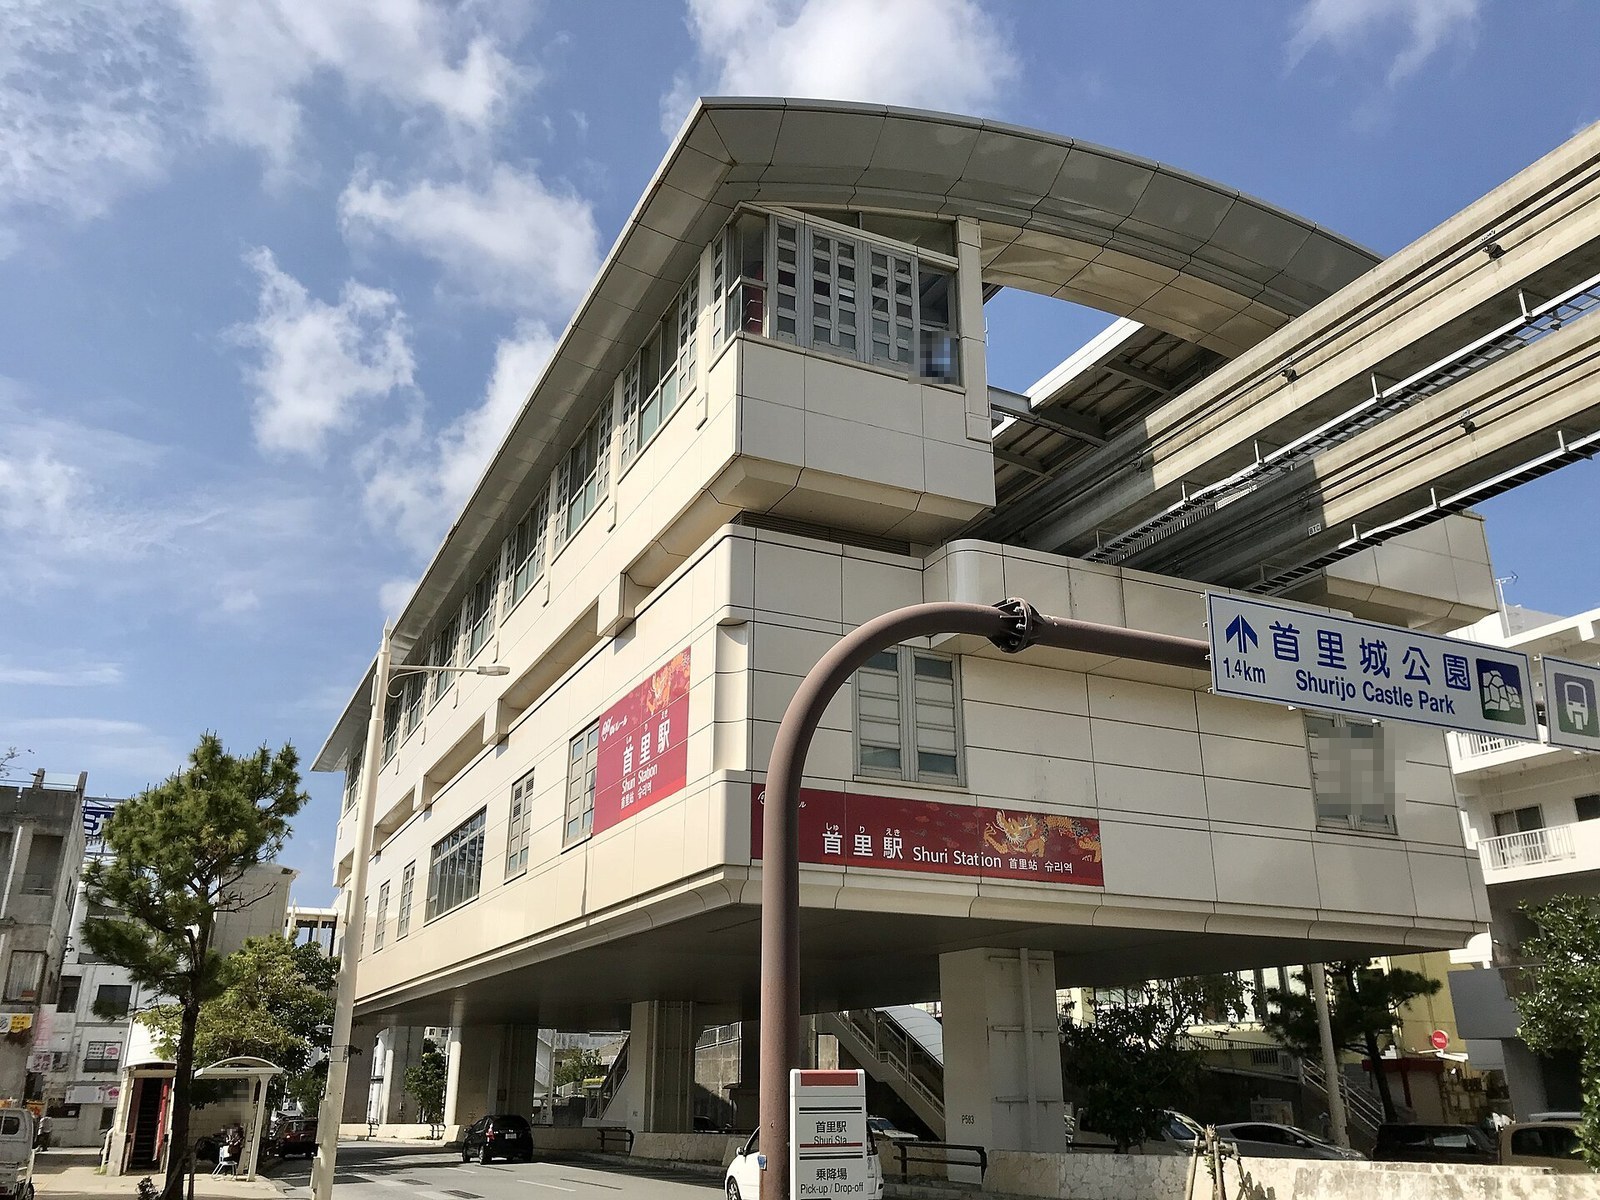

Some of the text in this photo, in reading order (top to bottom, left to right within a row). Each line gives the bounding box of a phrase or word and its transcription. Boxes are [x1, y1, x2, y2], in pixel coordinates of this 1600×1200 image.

[1269, 620, 1472, 692] 首里城公園
[1223, 657, 1266, 684] 1.4km
[1296, 669, 1456, 715] Shurijo Castle Park
[623, 718, 670, 777] 首里駅
[638, 763, 658, 785] Station
[825, 822, 901, 837] しゅ り えき
[822, 831, 904, 860] 首里駅
[913, 845, 1002, 868] Shuri Station
[1008, 857, 1038, 871] 首里站
[816, 1120, 847, 1133] 首里駅
[814, 1135, 833, 1145] Shuri
[816, 1168, 847, 1181] 乗降場
[800, 1183, 828, 1195] Pick-up
[834, 1181, 864, 1194] Drop-off
